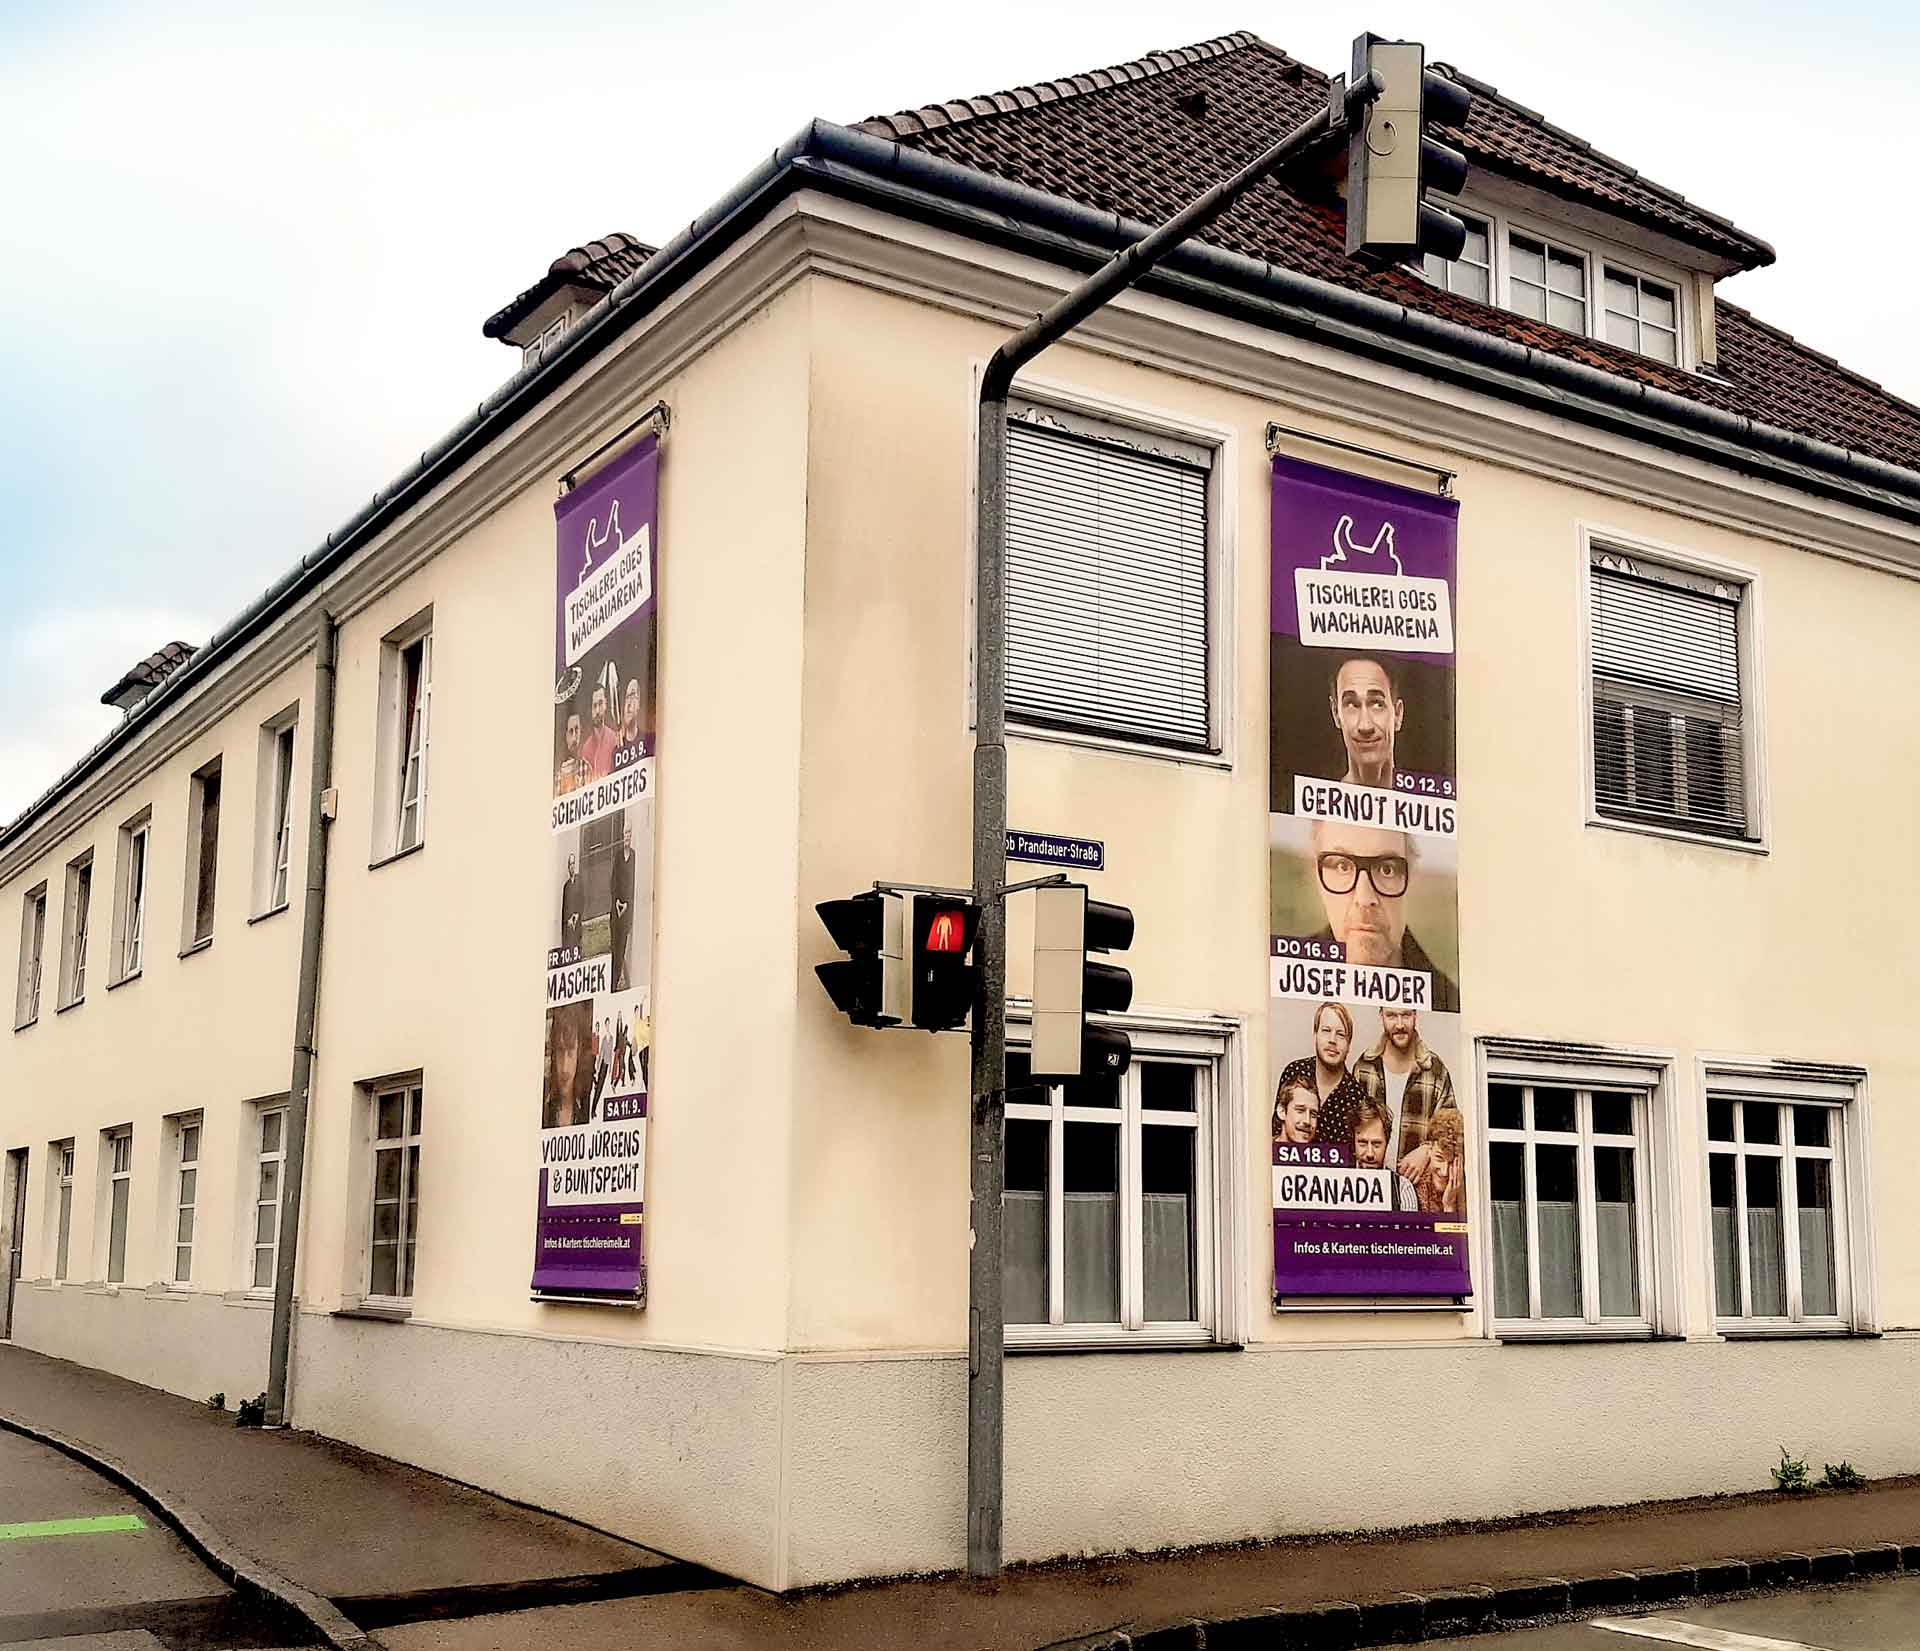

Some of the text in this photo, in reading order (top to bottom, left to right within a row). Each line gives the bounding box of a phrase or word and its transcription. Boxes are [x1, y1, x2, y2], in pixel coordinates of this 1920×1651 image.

[570, 544, 643, 624] TISCHLEREI GOES
[1306, 583, 1437, 611] TISCHLEREI GOES
[571, 572, 643, 650] WACHAUARENA
[1310, 611, 1439, 639] WACHAUARENA
[615, 749, 628, 767] DO
[639, 741, 647, 755] 9.
[552, 768, 647, 828] SCIENCE BUSTERS
[1395, 774, 1456, 796] SO 12. 9.
[1302, 785, 1455, 834] GERNOT KULIS
[1018, 837, 1099, 861] Prandtauer-Straße
[548, 947, 581, 966] FR 10. 9.
[1276, 939, 1344, 960] DO 16. 9.
[547, 963, 607, 1003] MASCHEK
[1279, 964, 1426, 1004] JOSEF HADER
[607, 1099, 641, 1117] SA 11. 9.
[542, 1129, 640, 1163] VOODOO JÜRGENS
[1279, 1146, 1345, 1164] SA 18. 9.
[553, 1163, 639, 1194] & BUNTSPECHT
[1281, 1174, 1384, 1205] GRANADA
[1294, 1241, 1453, 1257] Infos & Karten: tischlereimelk.at
